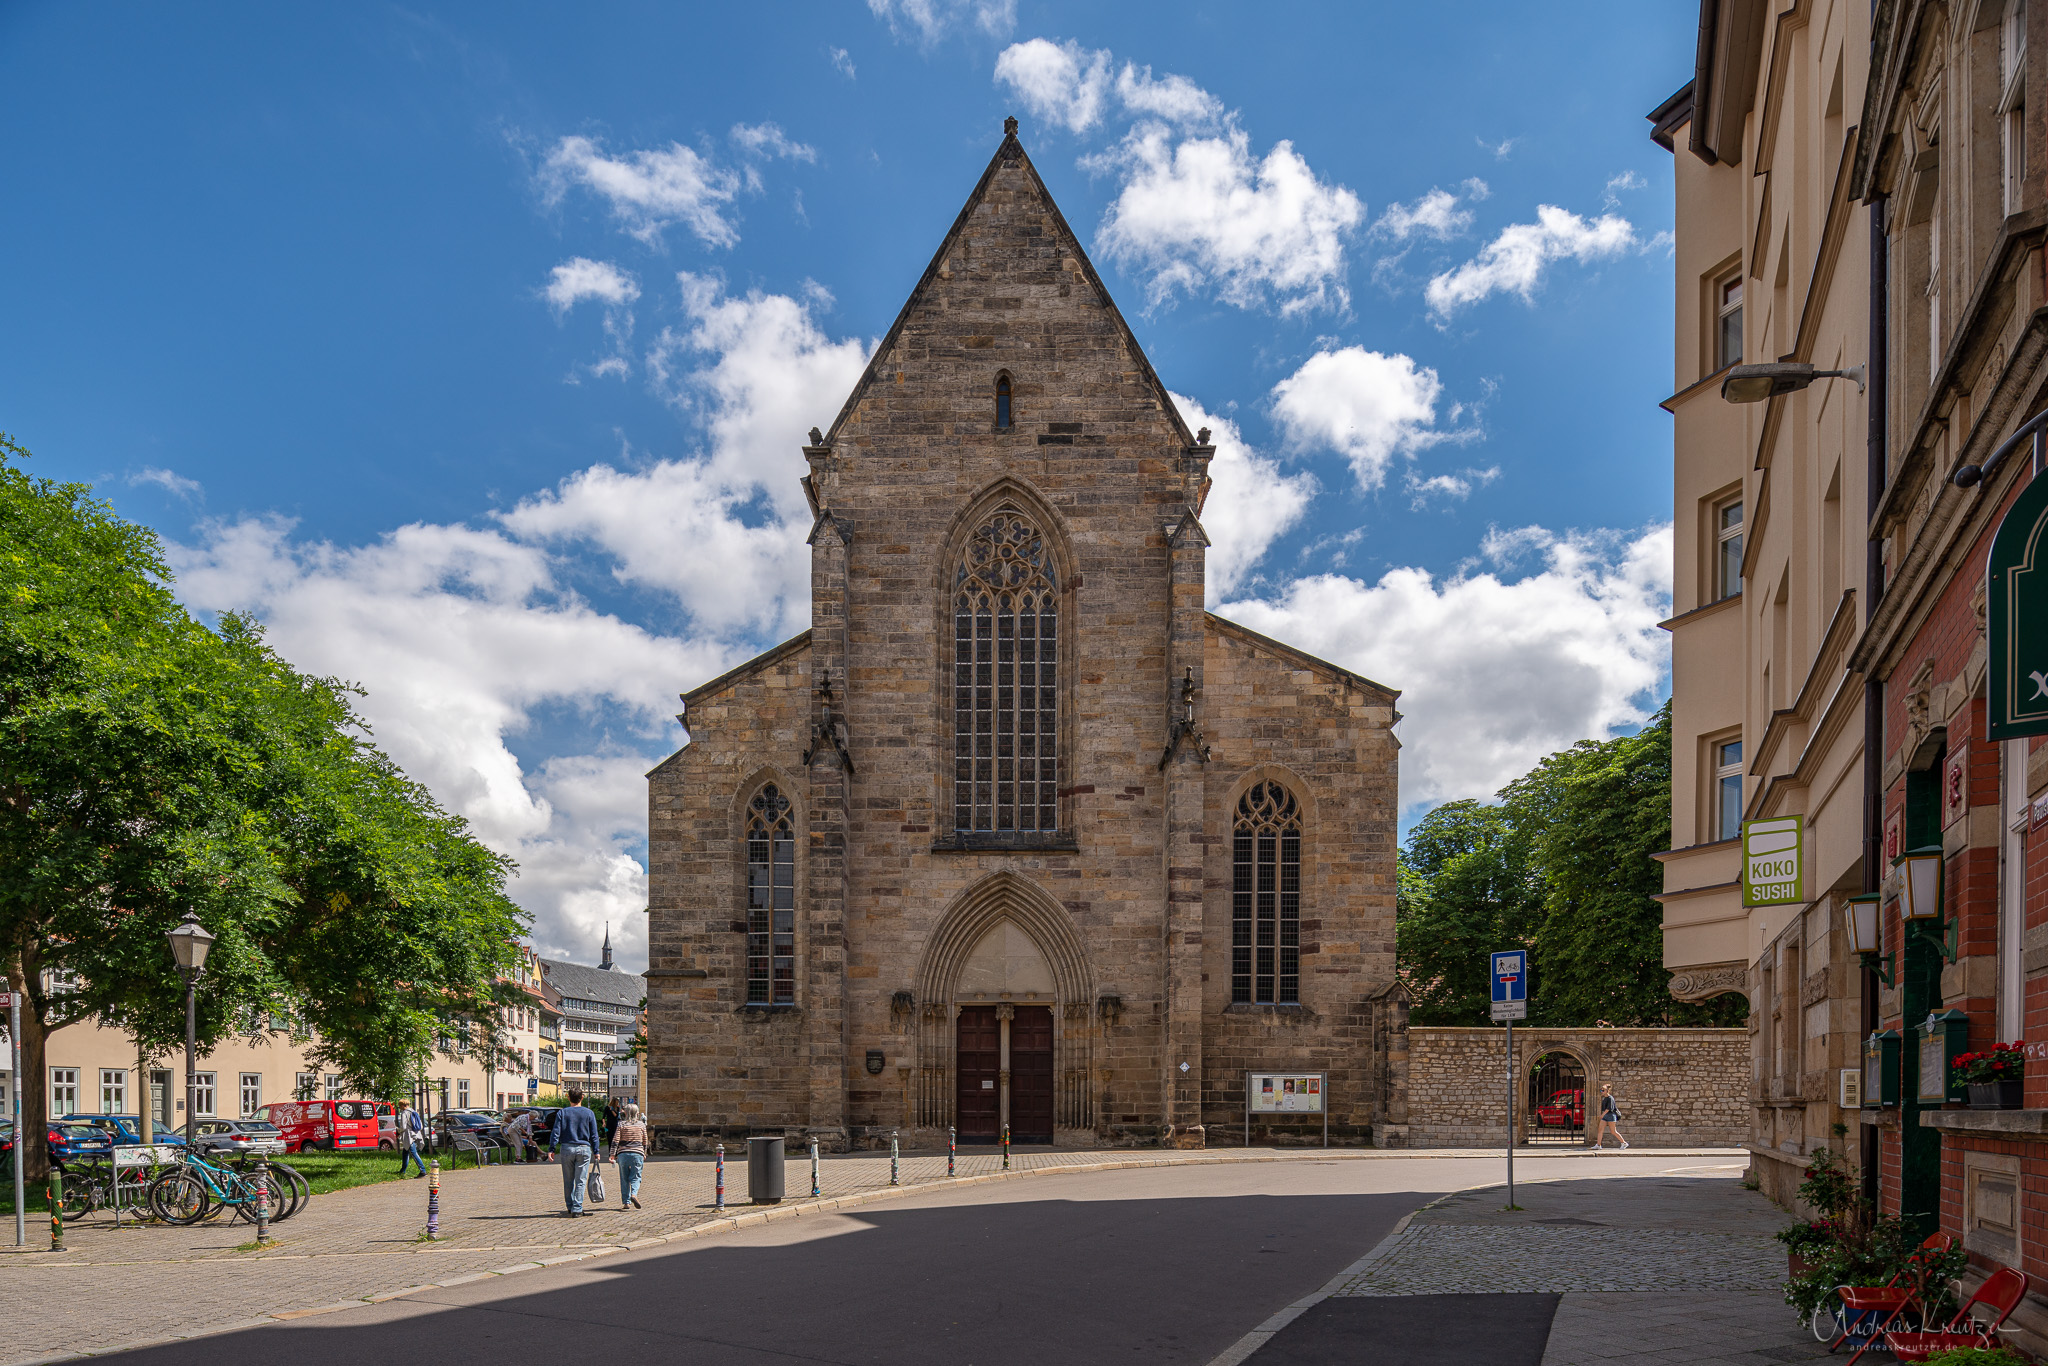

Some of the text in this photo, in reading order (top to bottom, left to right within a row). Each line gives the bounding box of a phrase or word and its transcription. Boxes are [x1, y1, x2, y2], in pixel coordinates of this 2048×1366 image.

[1752, 860, 1794, 879] KOKO
[1752, 883, 1795, 901] SUSHI
[281, 1114, 296, 1126] OX
